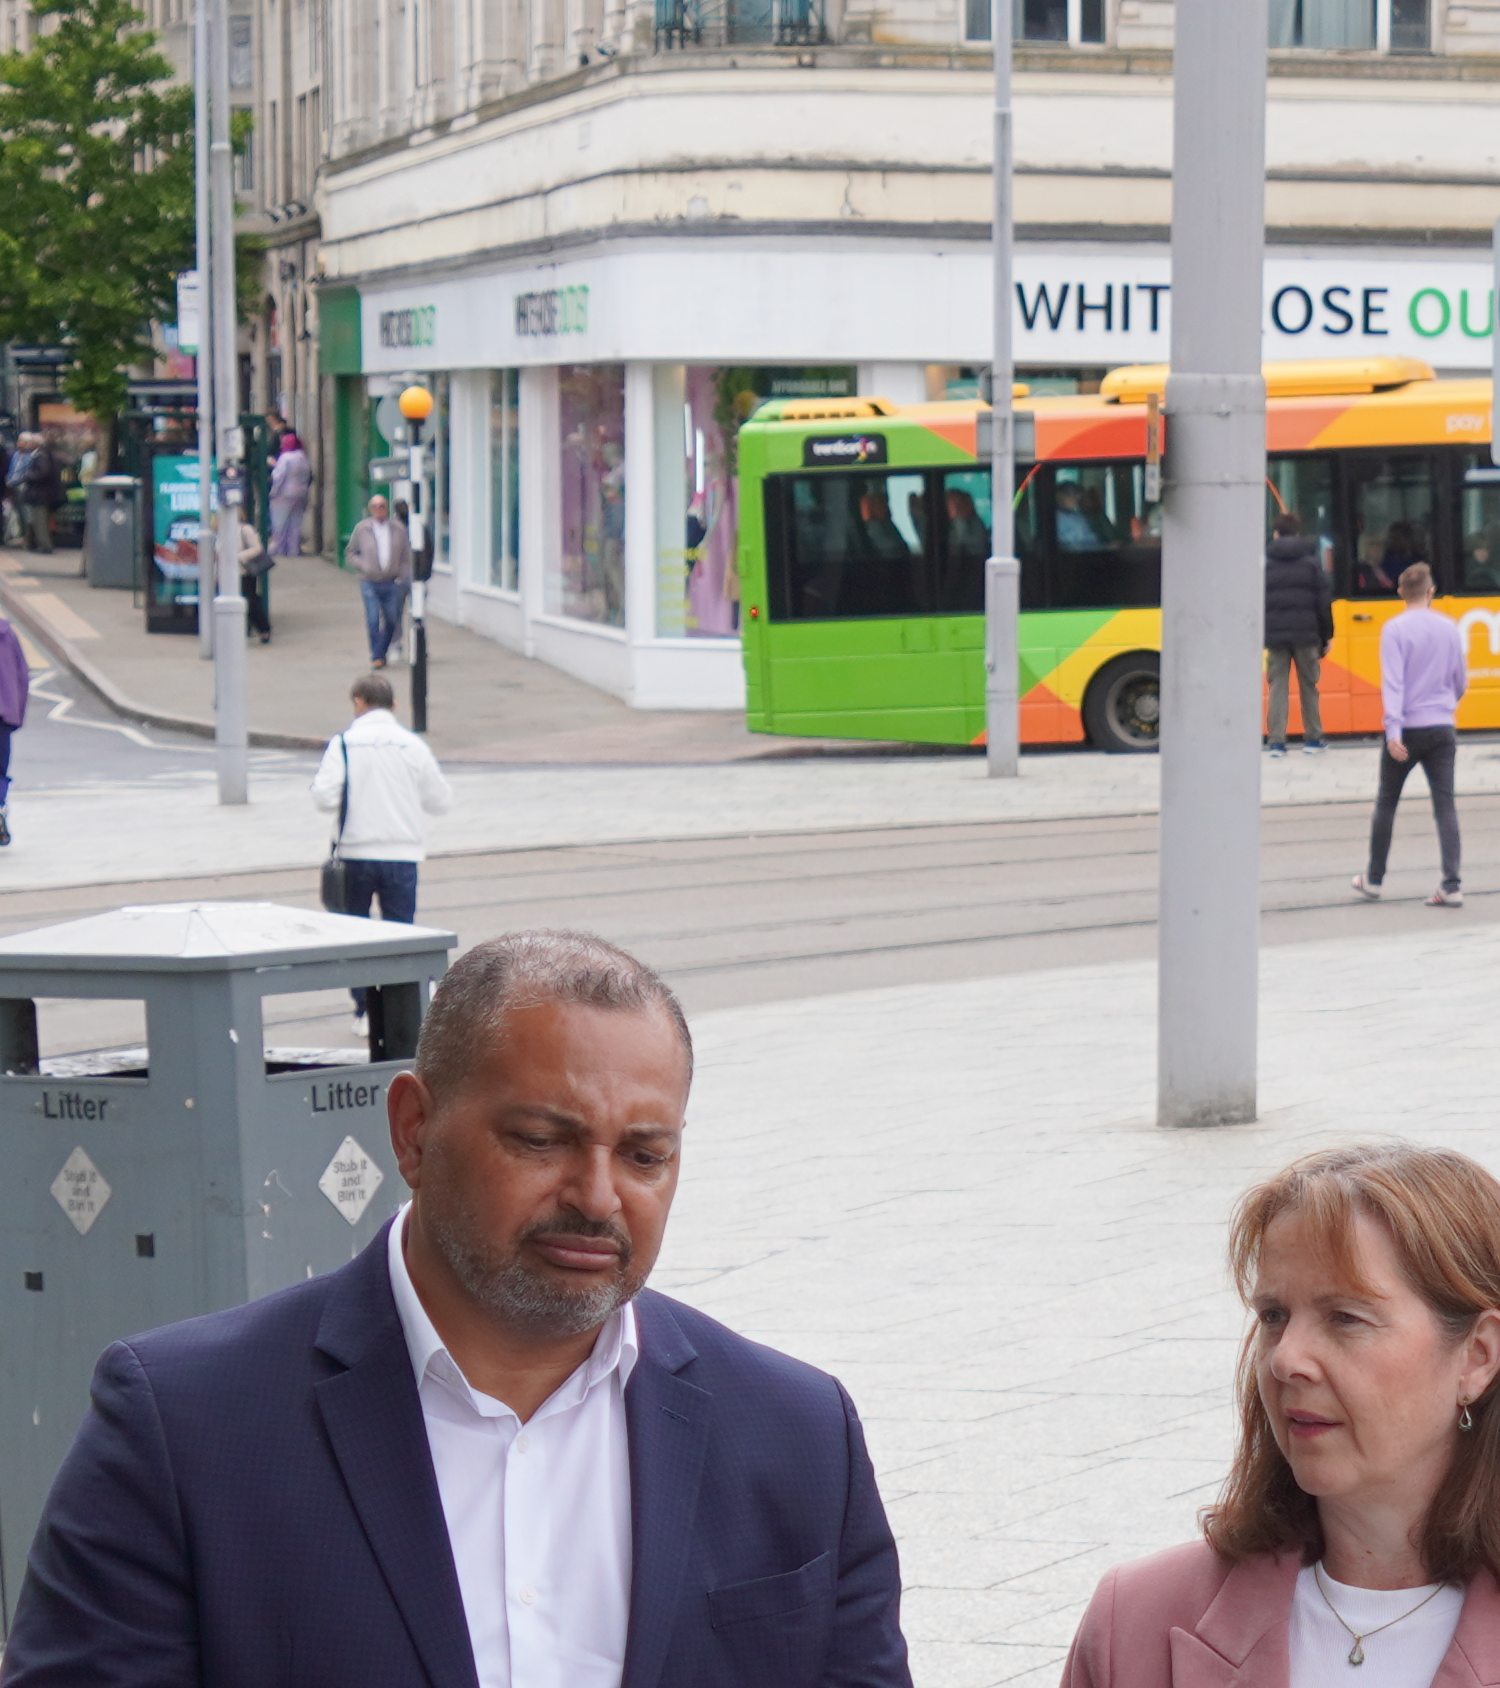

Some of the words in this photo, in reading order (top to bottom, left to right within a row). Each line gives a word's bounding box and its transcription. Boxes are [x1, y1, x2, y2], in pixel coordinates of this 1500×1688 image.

[1013, 282, 1172, 332] WHIT
[1270, 285, 1390, 335] OSE
[42, 1091, 108, 1120] Litter
[310, 1082, 380, 1112] Litter
[332, 1160, 358, 1174] Stub
[341, 1174, 360, 1187] and
[337, 1188, 356, 1202] Bin
